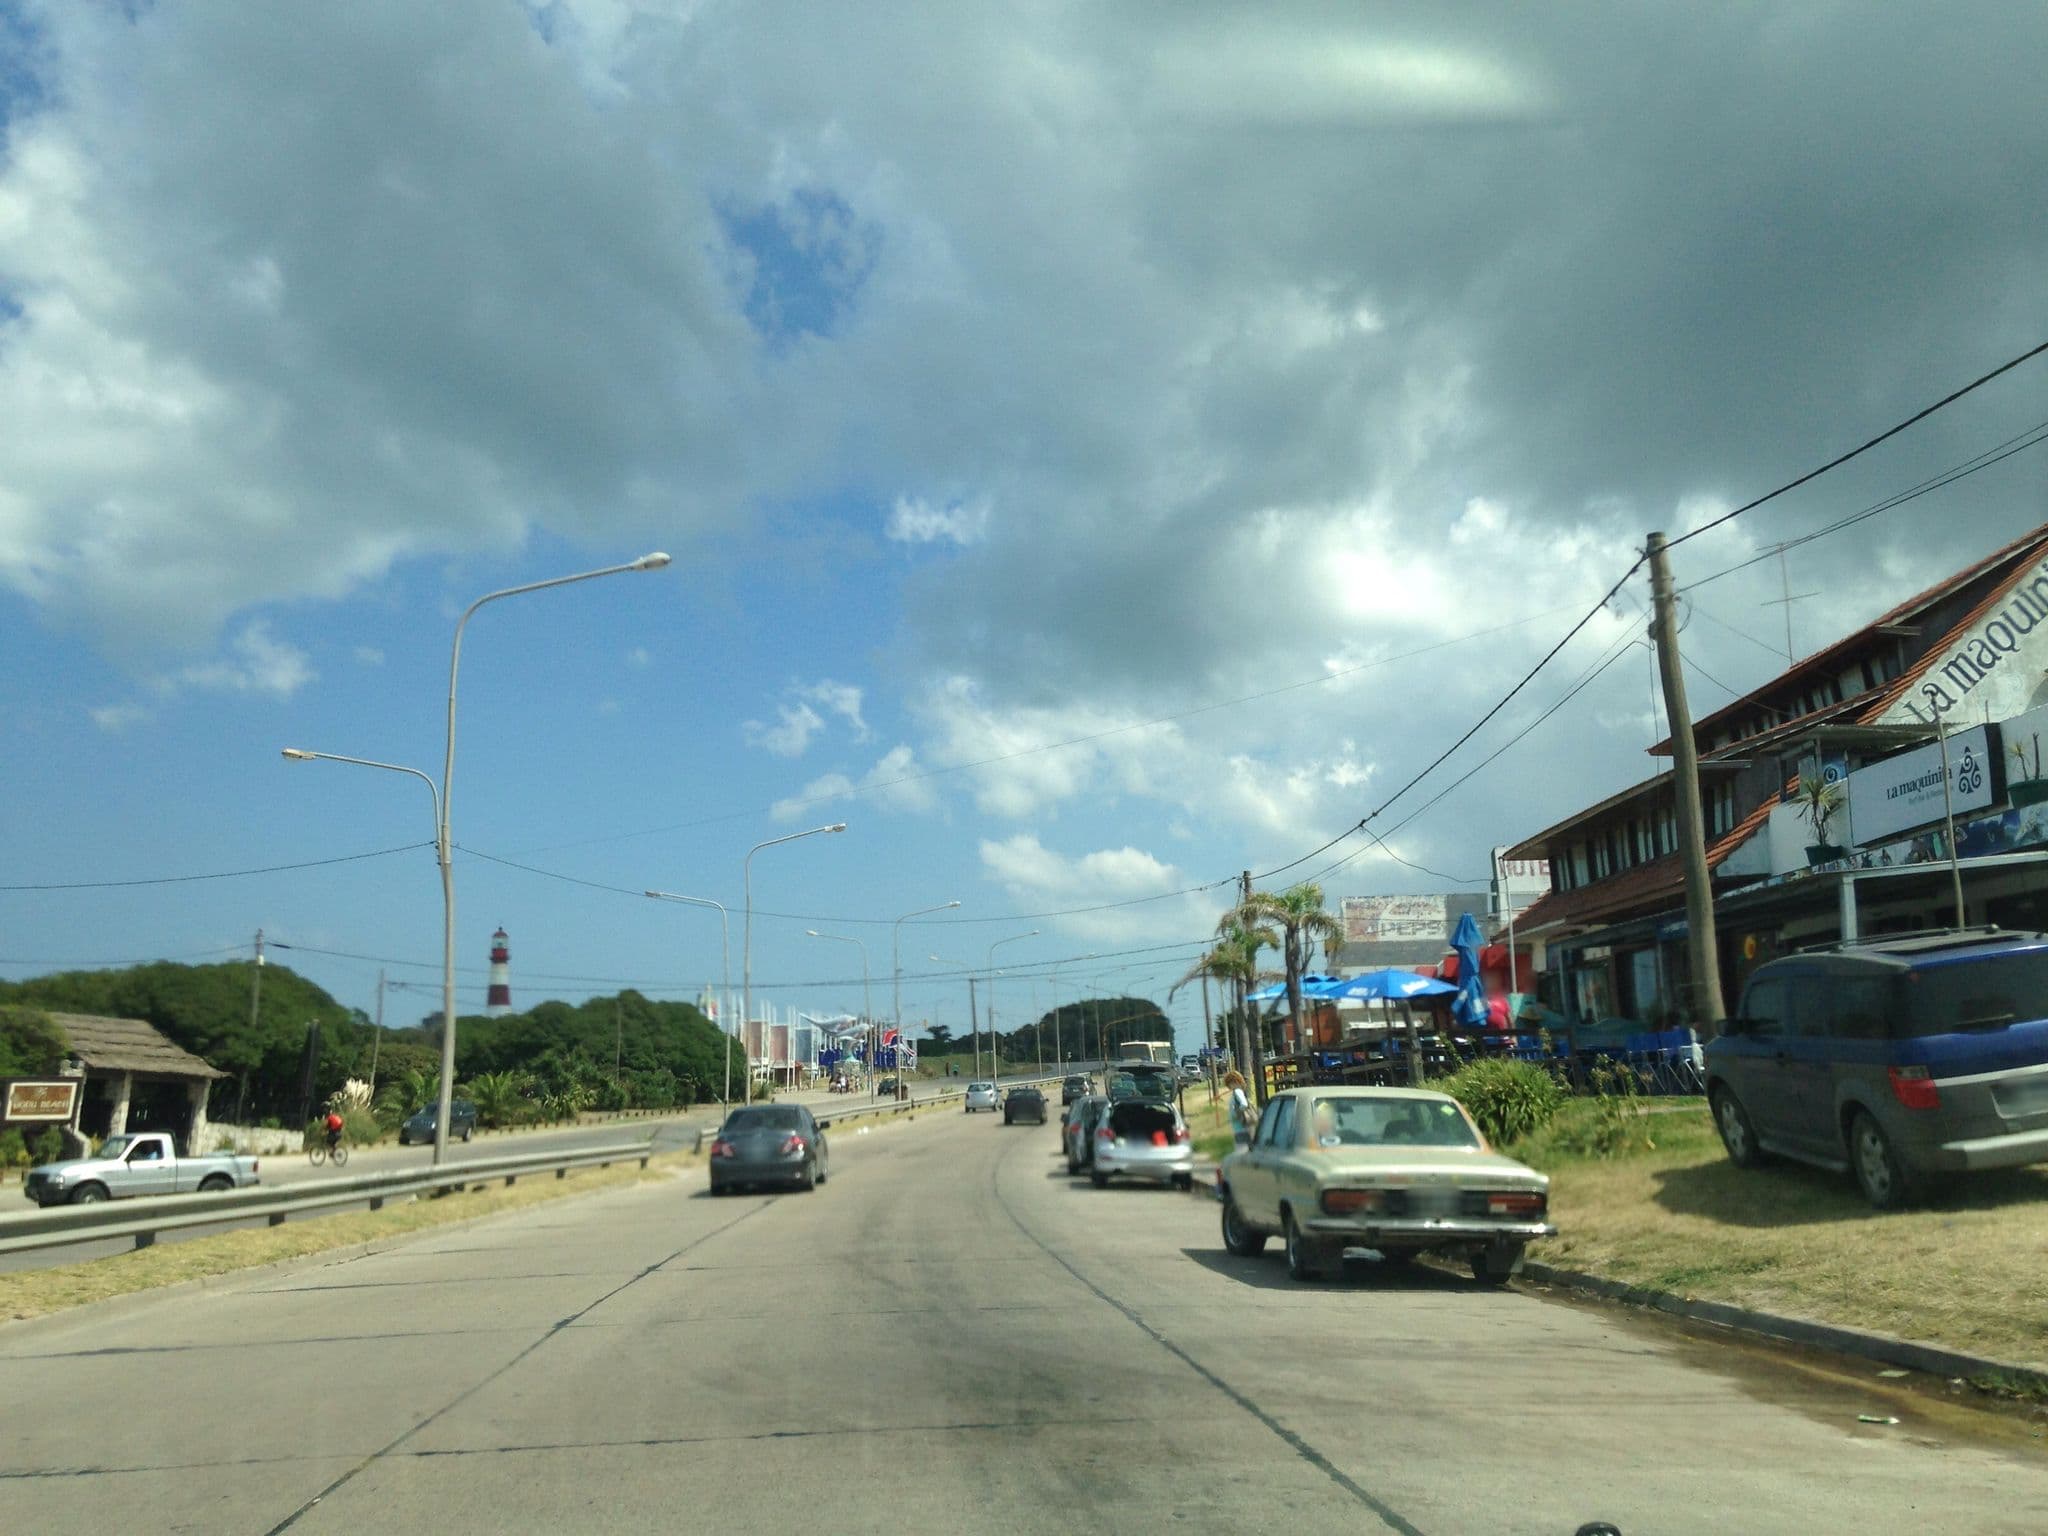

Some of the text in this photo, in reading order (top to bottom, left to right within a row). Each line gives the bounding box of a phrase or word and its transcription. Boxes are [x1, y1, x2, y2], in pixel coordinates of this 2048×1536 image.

[1903, 683, 1957, 723] La
[1940, 562, 2048, 695] maquin
[1886, 785, 1898, 800] La
[1900, 766, 1953, 795] maquinia
